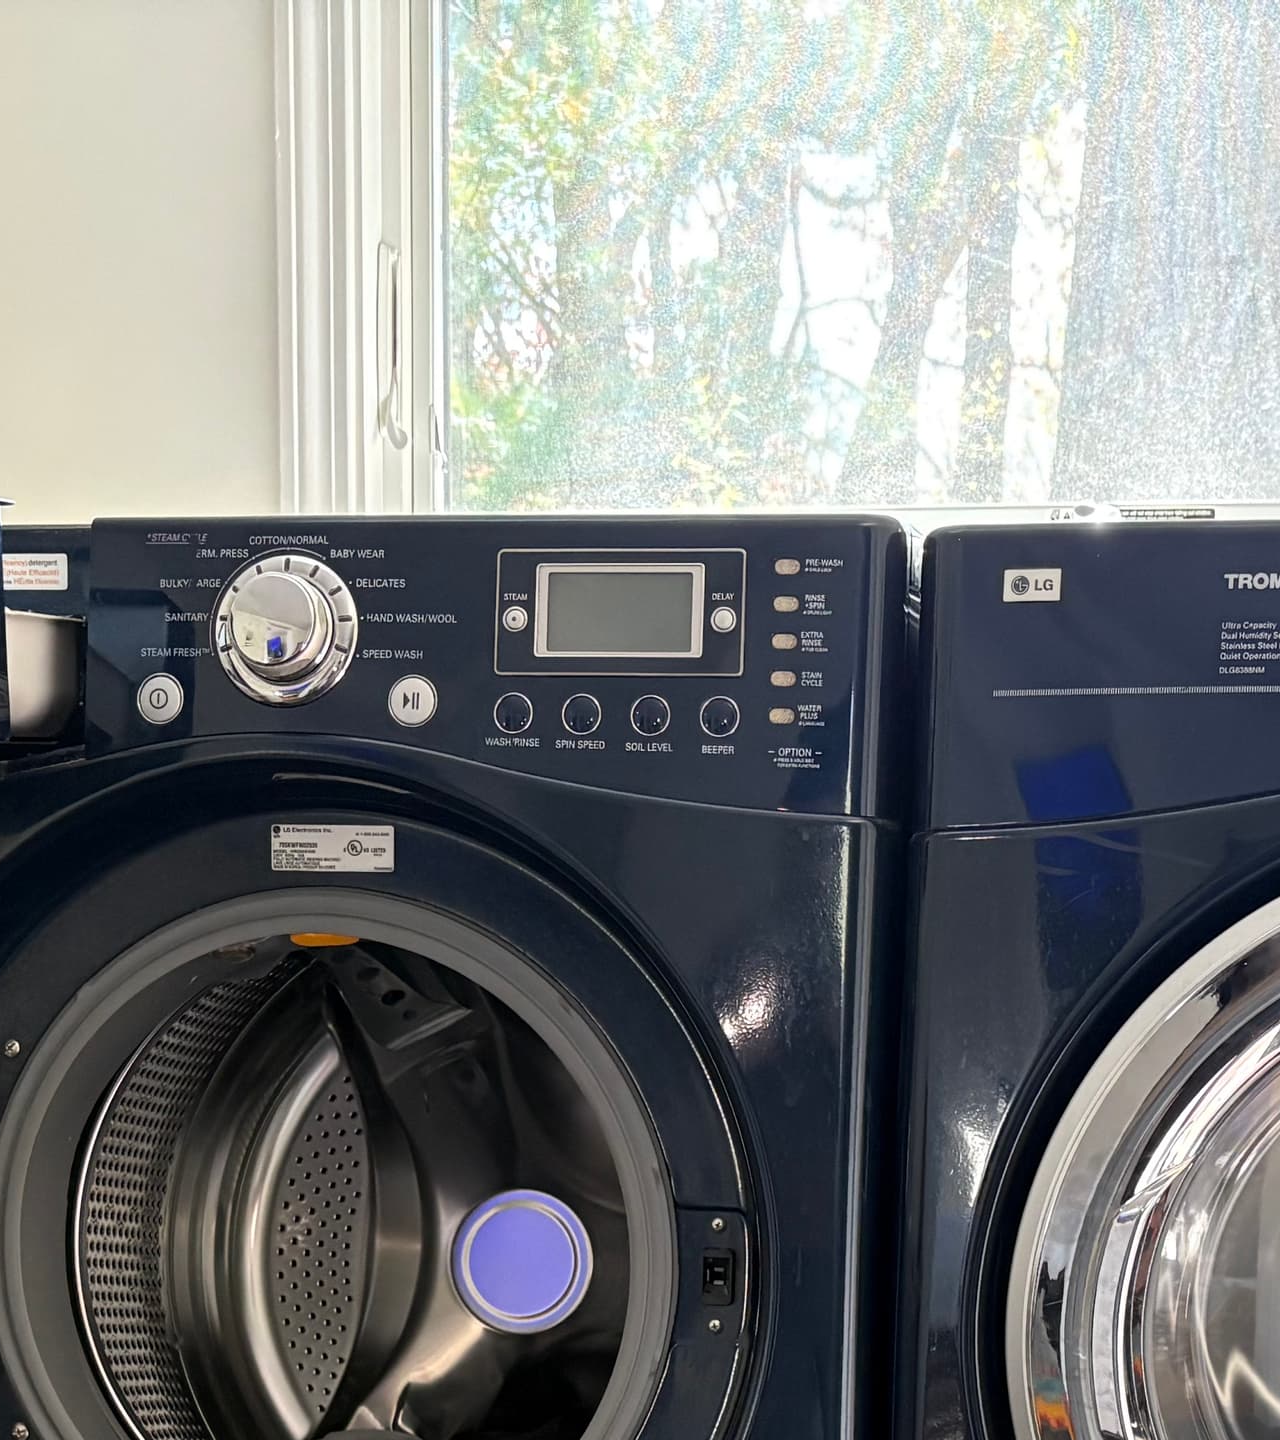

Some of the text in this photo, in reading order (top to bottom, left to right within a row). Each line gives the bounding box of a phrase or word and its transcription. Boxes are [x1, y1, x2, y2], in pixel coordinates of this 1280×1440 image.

[249, 536, 329, 545] COTTON/NORMAL
[220, 549, 249, 559] PRESS
[330, 549, 385, 559] BABY WEAR
[355, 578, 406, 588] DELICATES
[1034, 578, 1054, 592] LG
[503, 592, 528, 601] STEAM
[711, 592, 735, 601] DELAY
[164, 612, 209, 622] SANITARY
[366, 613, 458, 624] HAND WASH/WOOL
[1221, 621, 1278, 631] Ultra Capacity
[800, 631, 824, 639] EXTRA
[1221, 631, 1238, 640] Dual
[1239, 631, 1272, 641] Humidity
[1220, 641, 1256, 651] Stainless
[1257, 641, 1278, 650] Steel
[140, 648, 171, 657] STEAM
[362, 649, 424, 659] SPEED WASH
[1220, 652, 1241, 661] Quiet
[801, 671, 823, 679] STAIN
[801, 679, 824, 687] CYCLE
[797, 704, 822, 712] WATER
[799, 712, 818, 720] PLUS
[555, 739, 605, 750] SPIN SPEED
[625, 742, 673, 752] SOIL LEVEL
[701, 744, 735, 755] BEEPER
[778, 747, 812, 757] OPTION
